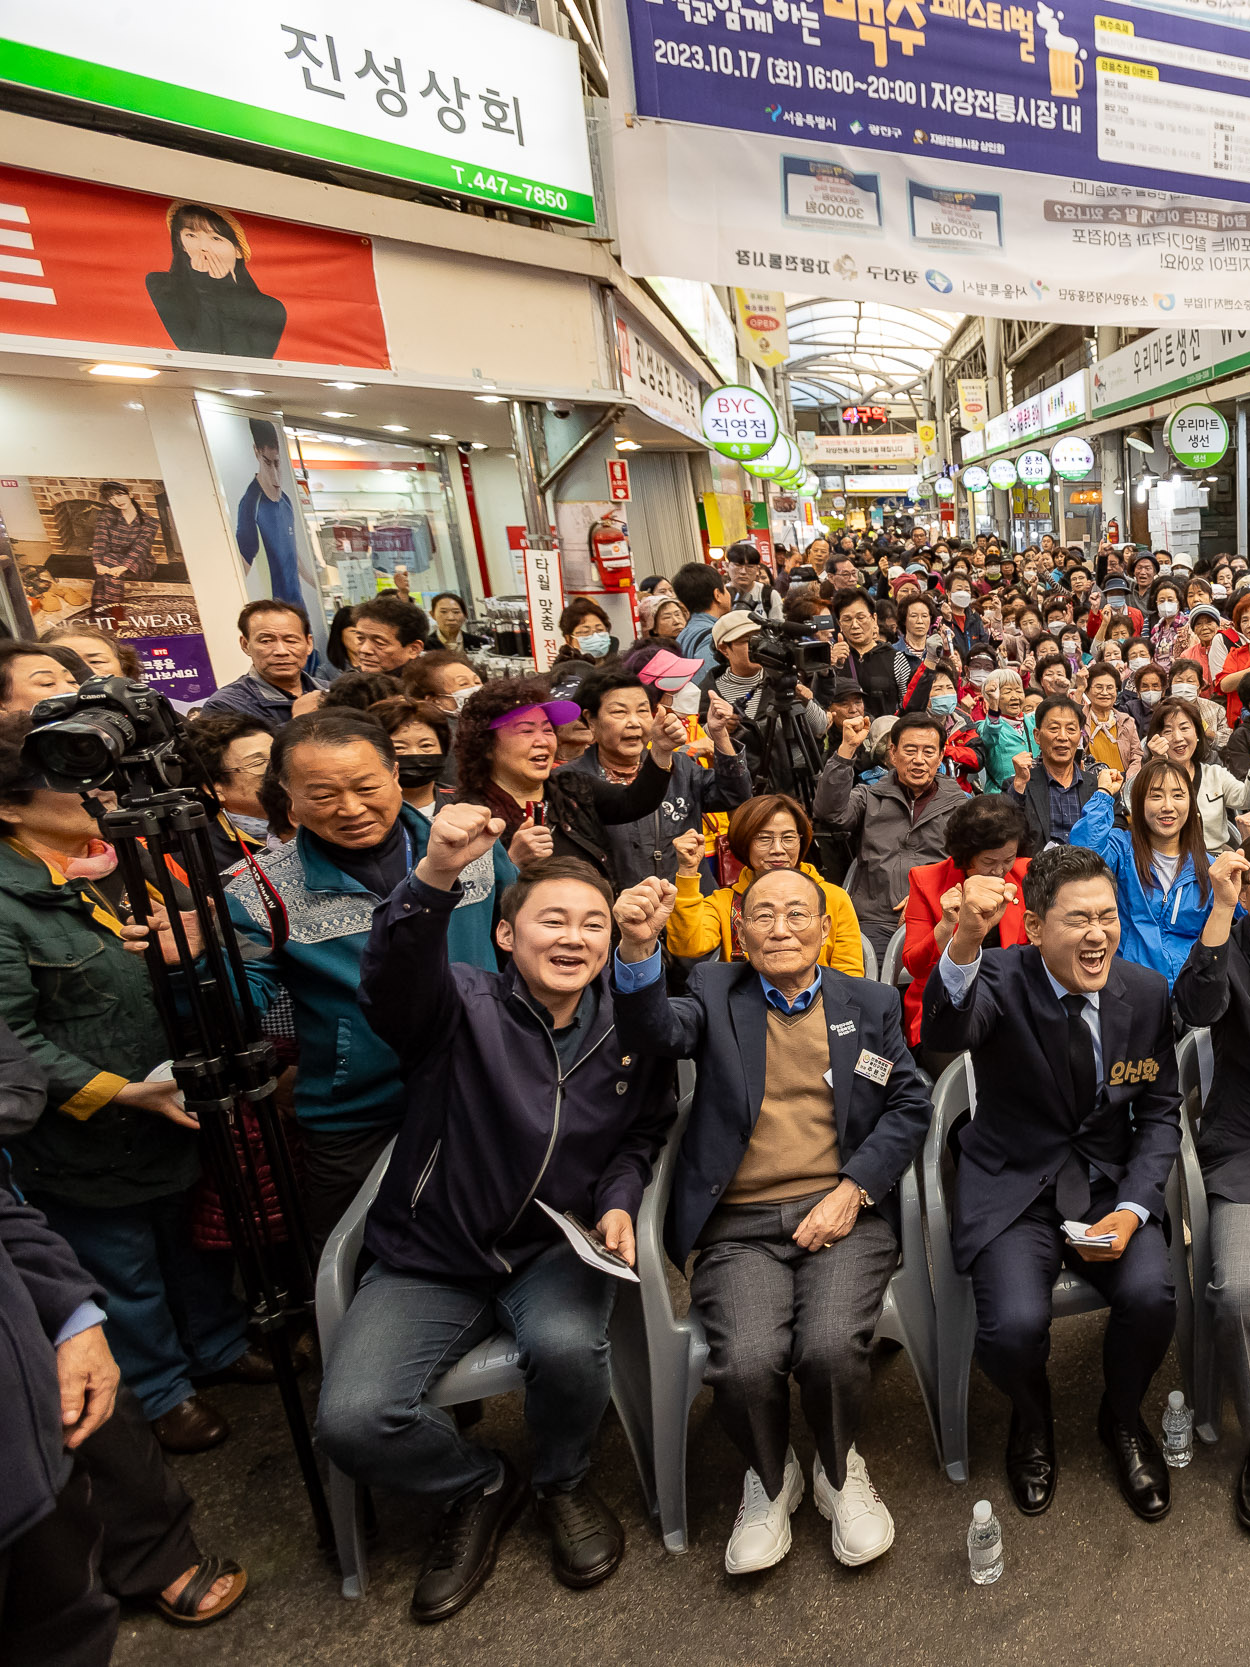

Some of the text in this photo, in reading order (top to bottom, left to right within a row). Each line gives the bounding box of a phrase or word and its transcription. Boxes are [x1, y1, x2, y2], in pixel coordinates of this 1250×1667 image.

[930, 0, 1036, 64] 페스티벌
[280, 23, 525, 147] 진성상회
[654, 39, 760, 80] 2023.10.17
[767, 56, 800, 88] (화)
[807, 68, 916, 104] 16:00~20:00
[931, 82, 1056, 130] 자양전통시장
[1062, 103, 1082, 134] 내
[783, 110, 837, 132] 서울특별시
[451, 165, 569, 212] T.447-7850
[749, 317, 778, 330] OPEN
[717, 398, 756, 414] BYC
[842, 406, 888, 424] 4구역
[711, 418, 768, 438] 직영점
[1176, 419, 1220, 432] 우리마트
[730, 444, 752, 456] 속옷
[1188, 435, 1210, 448] 생선
[1192, 454, 1207, 463] 생선
[536, 558, 550, 591] 타월
[129, 613, 194, 629] WEAR
[539, 599, 554, 632] 맞춤
[1109, 1057, 1160, 1088] 오신환
